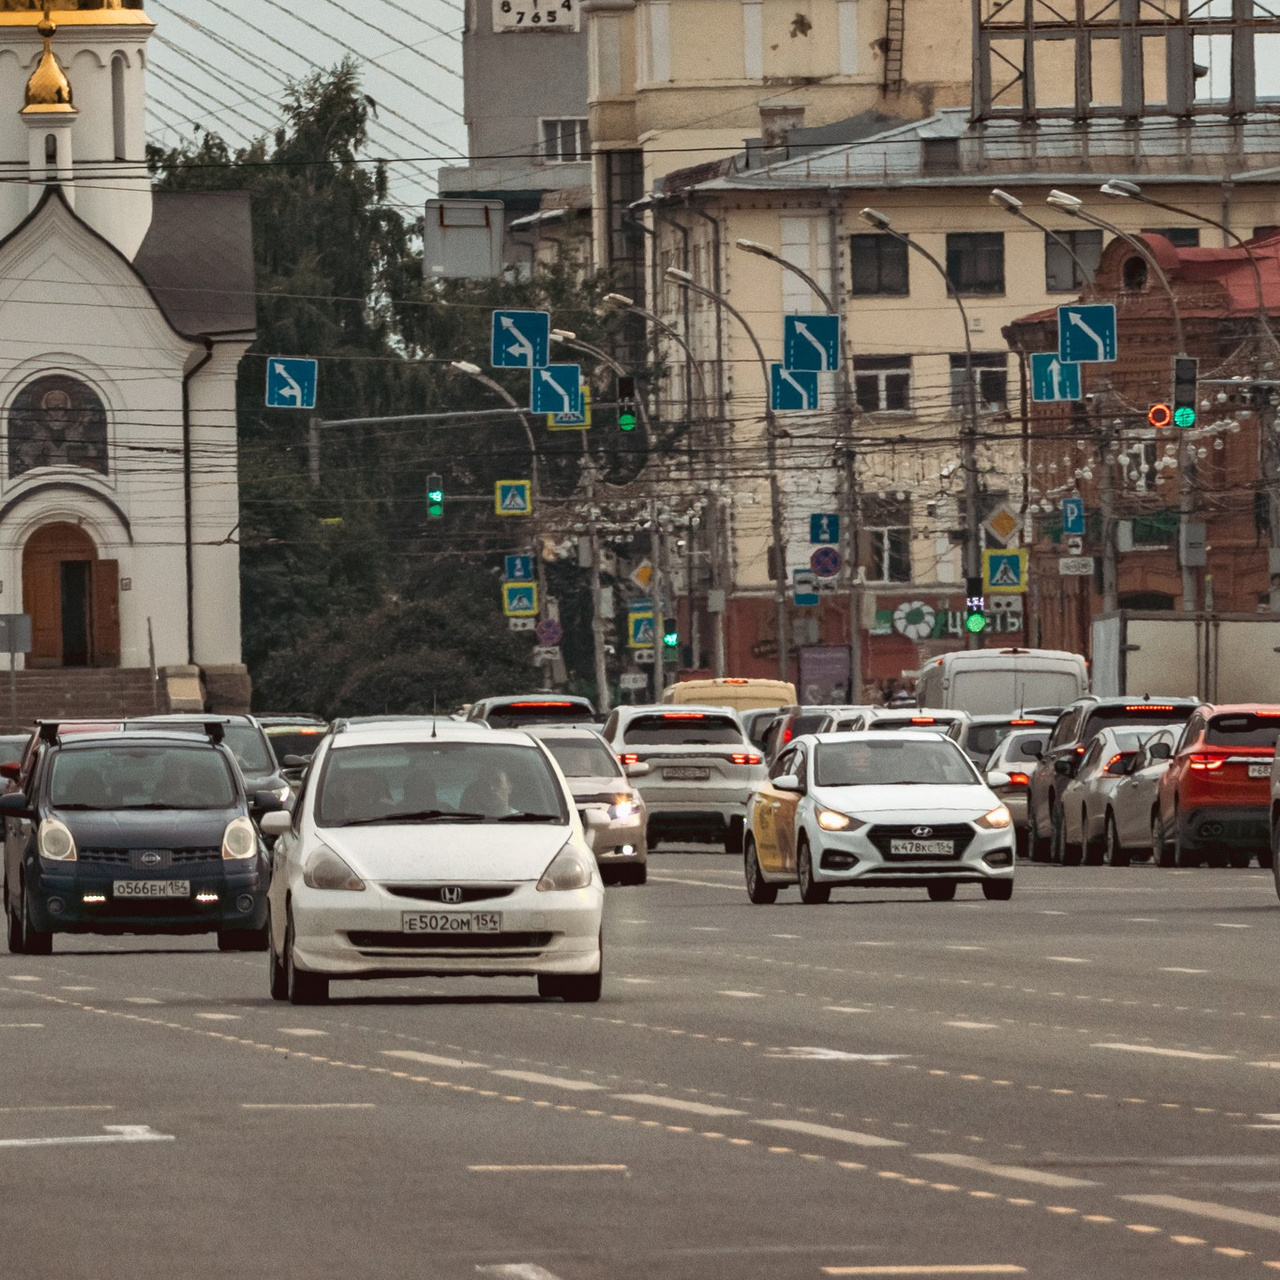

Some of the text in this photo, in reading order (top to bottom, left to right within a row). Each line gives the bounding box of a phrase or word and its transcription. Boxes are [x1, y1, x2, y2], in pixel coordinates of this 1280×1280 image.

[501, 0, 512, 13] 8
[561, 0, 572, 12] 4
[516, 11, 525, 24] 7
[531, 11, 541, 23] 6
[547, 10, 557, 23] 5
[948, 609, 1023, 638] ЦЕТЫ
